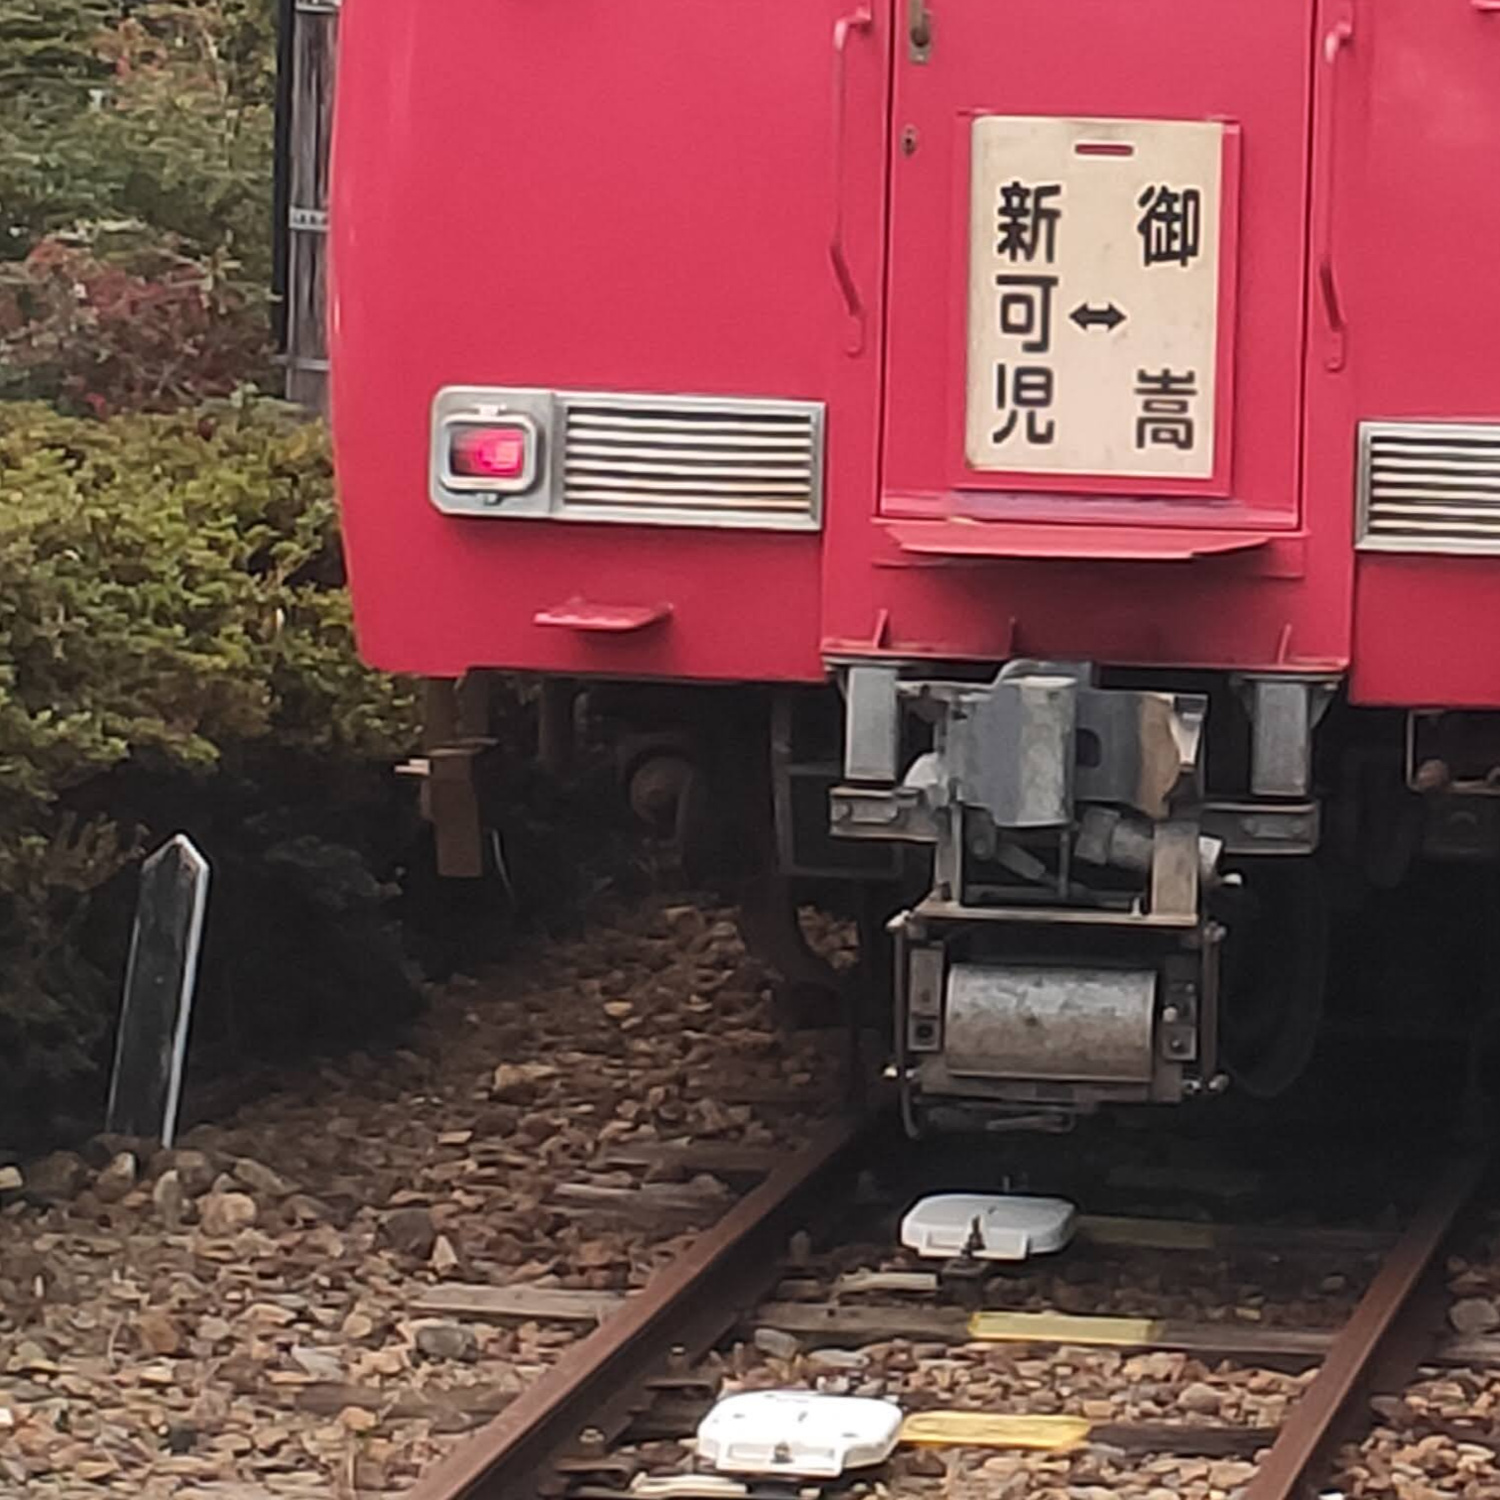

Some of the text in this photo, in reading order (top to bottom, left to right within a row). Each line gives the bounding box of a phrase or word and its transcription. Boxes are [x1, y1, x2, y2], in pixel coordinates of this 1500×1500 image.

[993, 181, 1061, 444] 新可児
[1133, 185, 1201, 449] 御嵩
